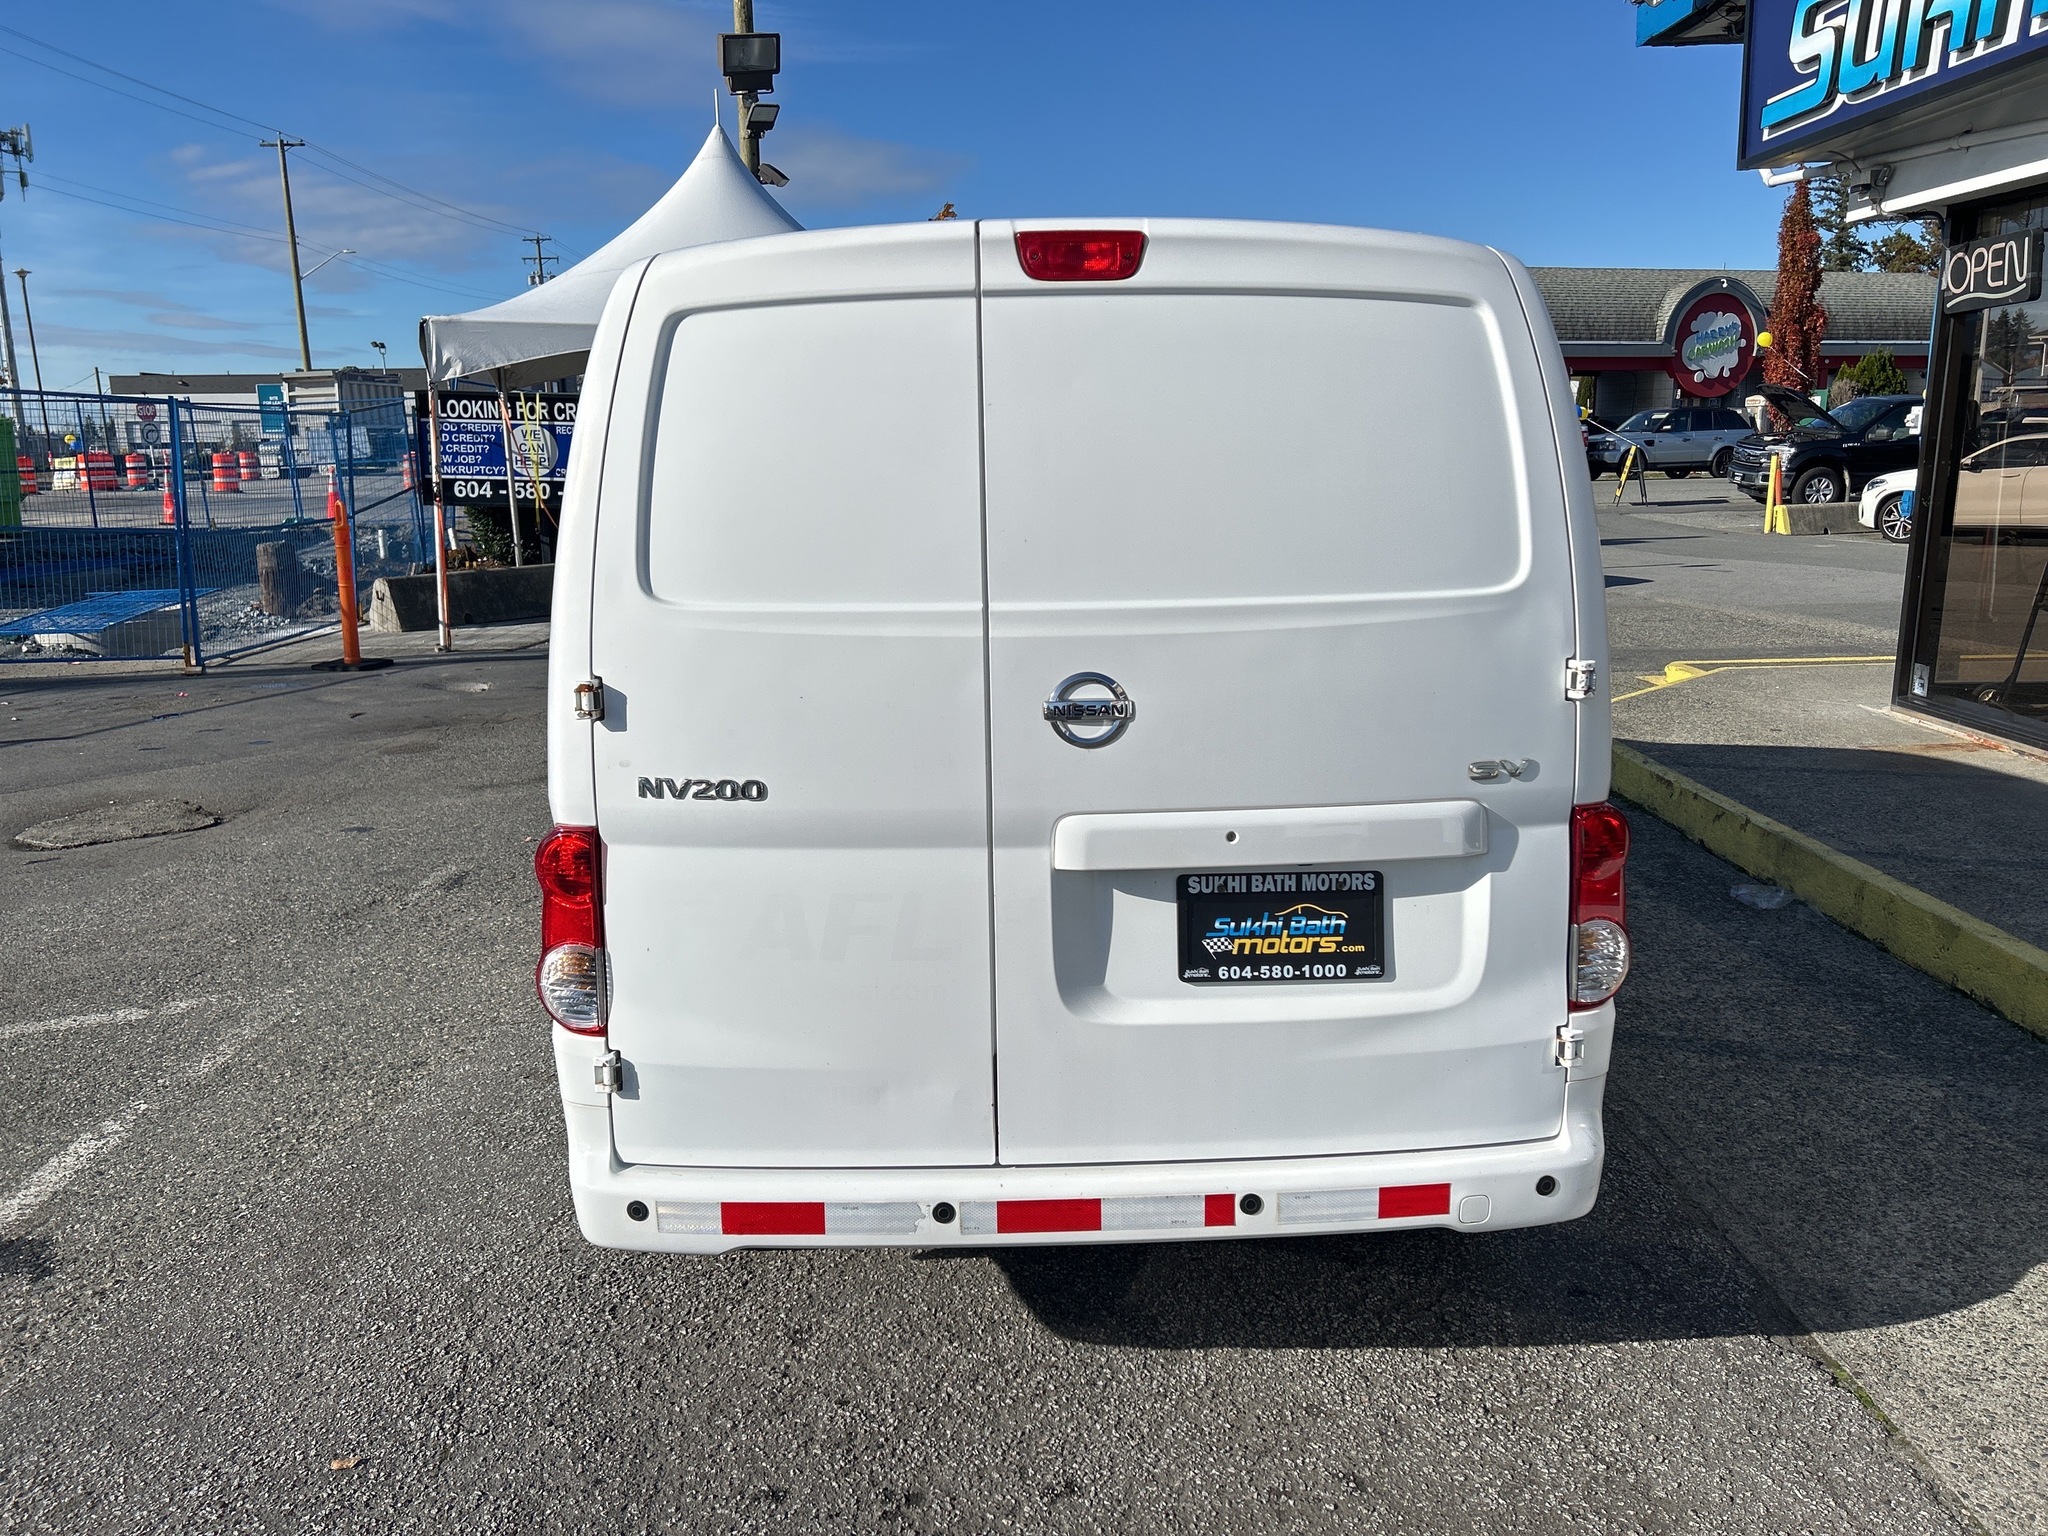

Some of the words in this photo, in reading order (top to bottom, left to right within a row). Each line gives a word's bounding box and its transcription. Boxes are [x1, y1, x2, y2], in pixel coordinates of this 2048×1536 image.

[1947, 236, 2029, 294] OPEN
[1687, 335, 1737, 361] CARWASH
[137, 405, 155, 416] STOP
[516, 402, 550, 420] FOR
[460, 423, 503, 433] CREDIT?
[451, 433, 496, 443] CREDIT?
[445, 444, 490, 454] CREDIT?
[454, 455, 482, 464] JOB?
[453, 481, 493, 498] 604
[514, 482, 551, 500] 580
[1053, 704, 1125, 717] NISSAN
[1467, 758, 1532, 780] SV
[637, 777, 769, 802] NV200
[1187, 875, 1247, 894] SUKHI
[1251, 874, 1297, 892] BATH
[1301, 872, 1376, 891] MOTORS
[1205, 912, 1284, 937] Sukhi
[1289, 916, 1347, 935] Bath
[1218, 964, 1347, 980] 604-580-1000
